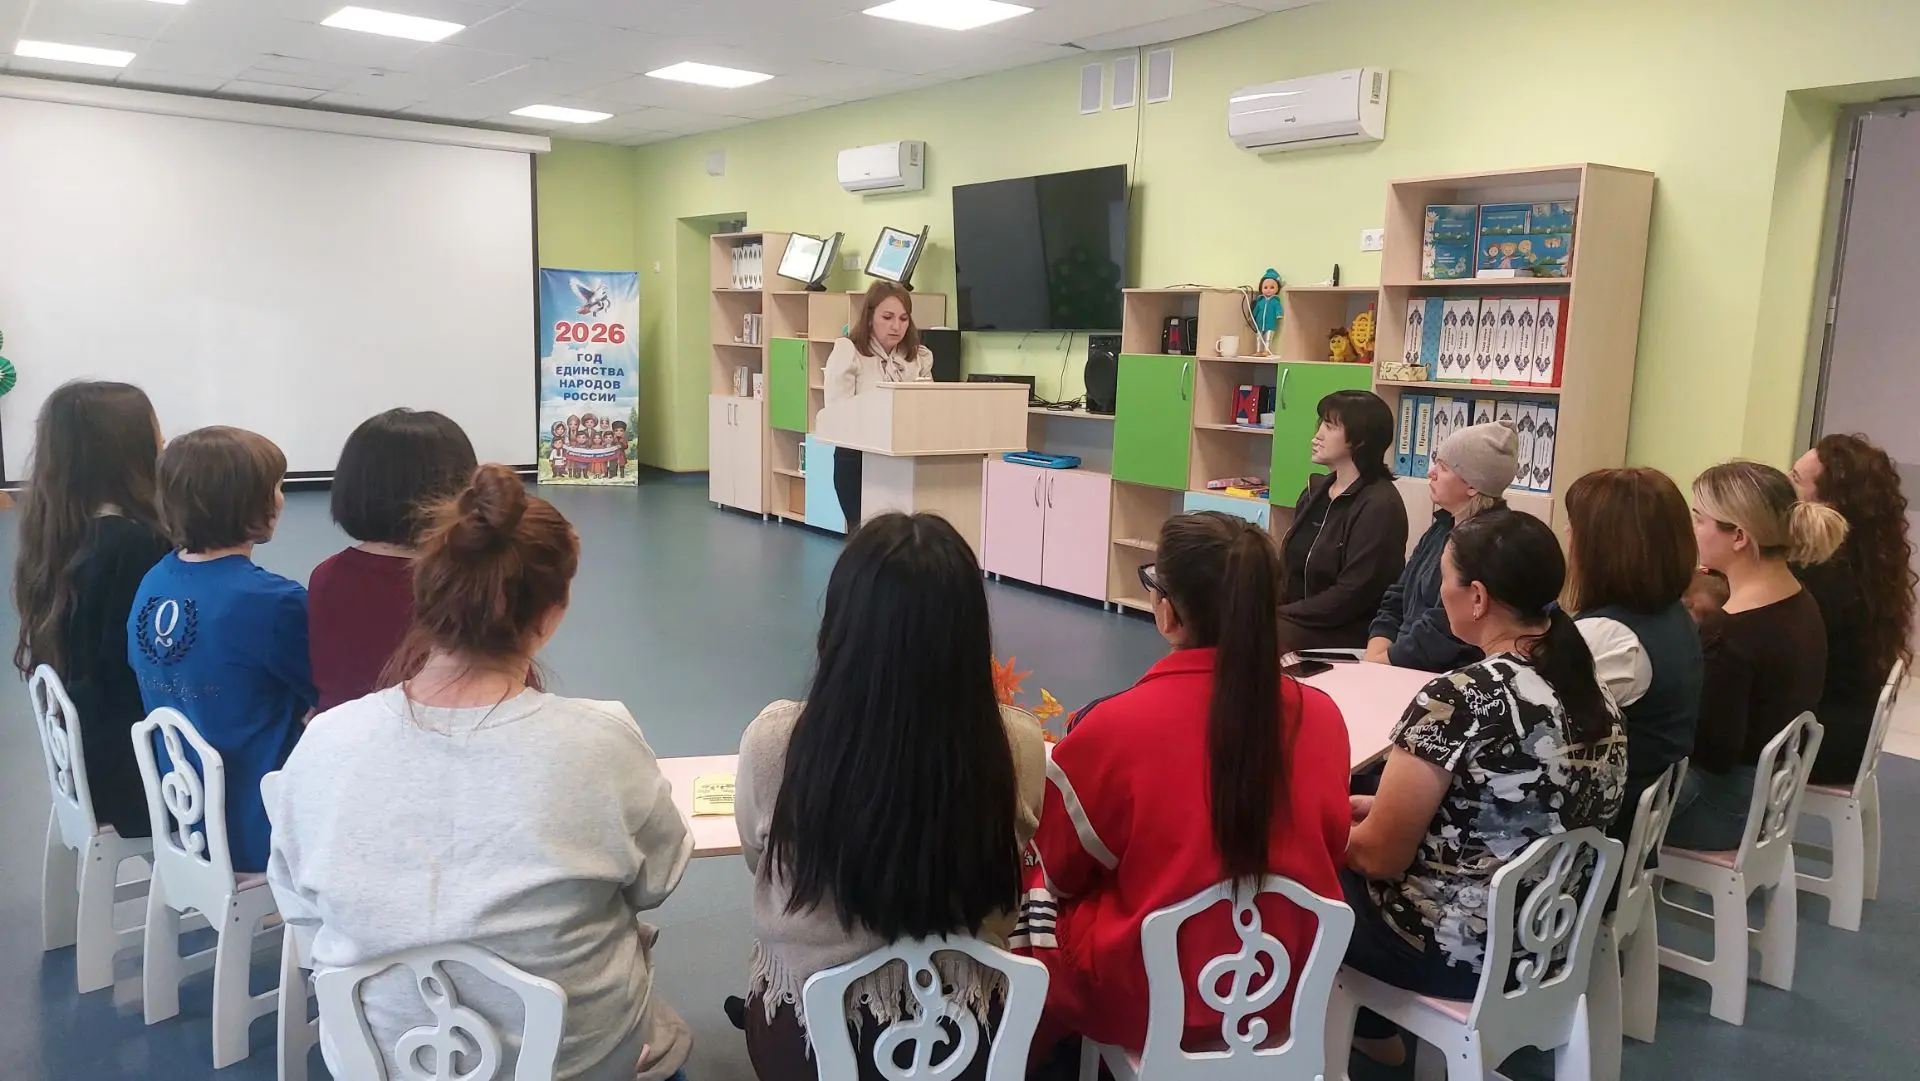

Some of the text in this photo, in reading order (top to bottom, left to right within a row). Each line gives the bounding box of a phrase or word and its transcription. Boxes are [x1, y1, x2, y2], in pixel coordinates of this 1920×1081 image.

[555, 321, 625, 344] 2026
[577, 353, 603, 364] ГОД
[555, 366, 625, 377] ЕДИНСТВА
[559, 379, 621, 390] НАРОДОВ
[563, 392, 616, 402] РОССИИ
[154, 600, 179, 647] Q
